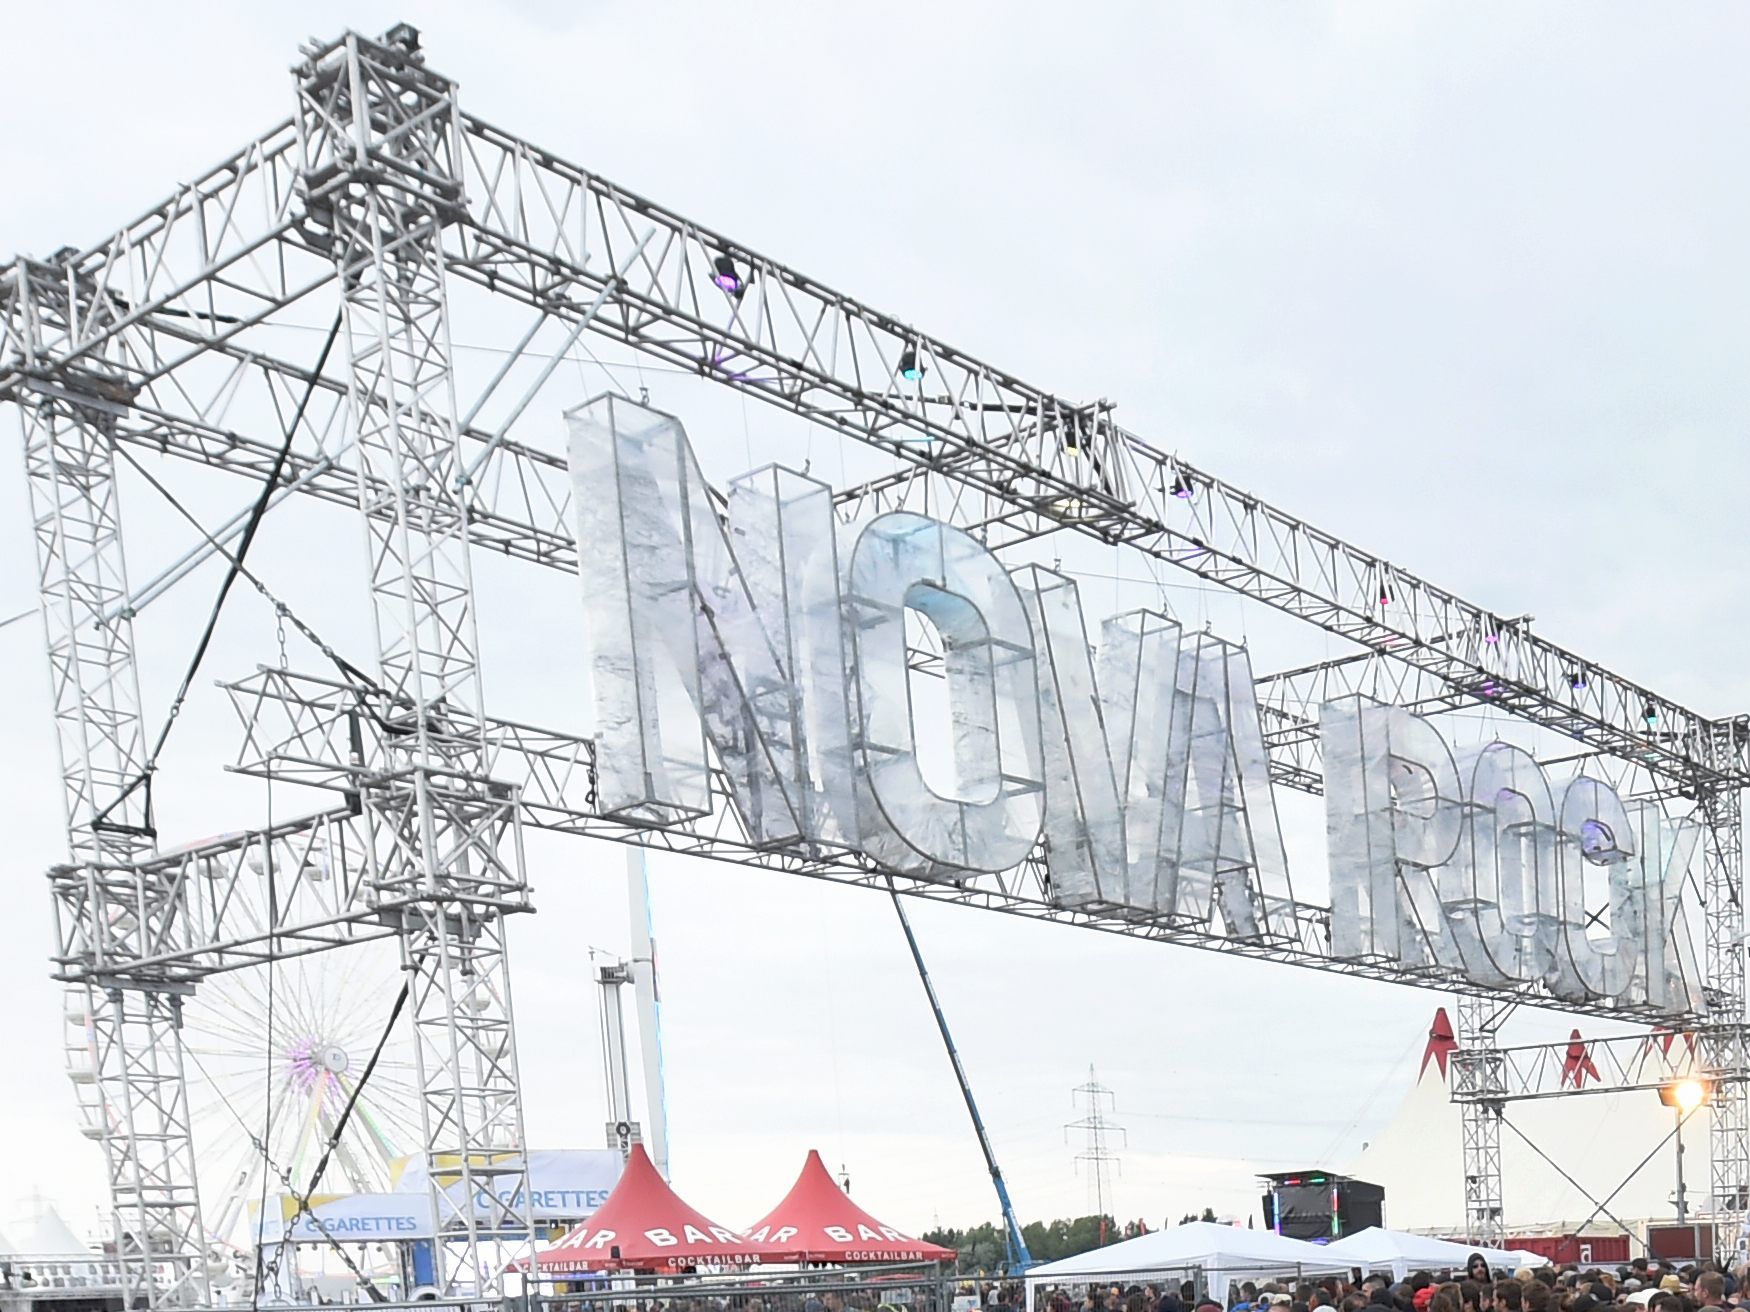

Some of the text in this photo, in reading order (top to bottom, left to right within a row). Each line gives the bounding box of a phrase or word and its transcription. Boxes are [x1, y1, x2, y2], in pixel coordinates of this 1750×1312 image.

[565, 391, 1703, 1025] NOVA ROCK
[477, 1191, 609, 1208] CGARETTES
[306, 1216, 417, 1232] CGARETTES
[644, 1225, 742, 1247] BAR
[824, 1224, 908, 1242] BAR
[668, 1254, 761, 1267] COCKTAILBAR
[845, 1251, 923, 1260] COCKTAILBAR
[522, 1262, 588, 1273] CCKTAILBAR
